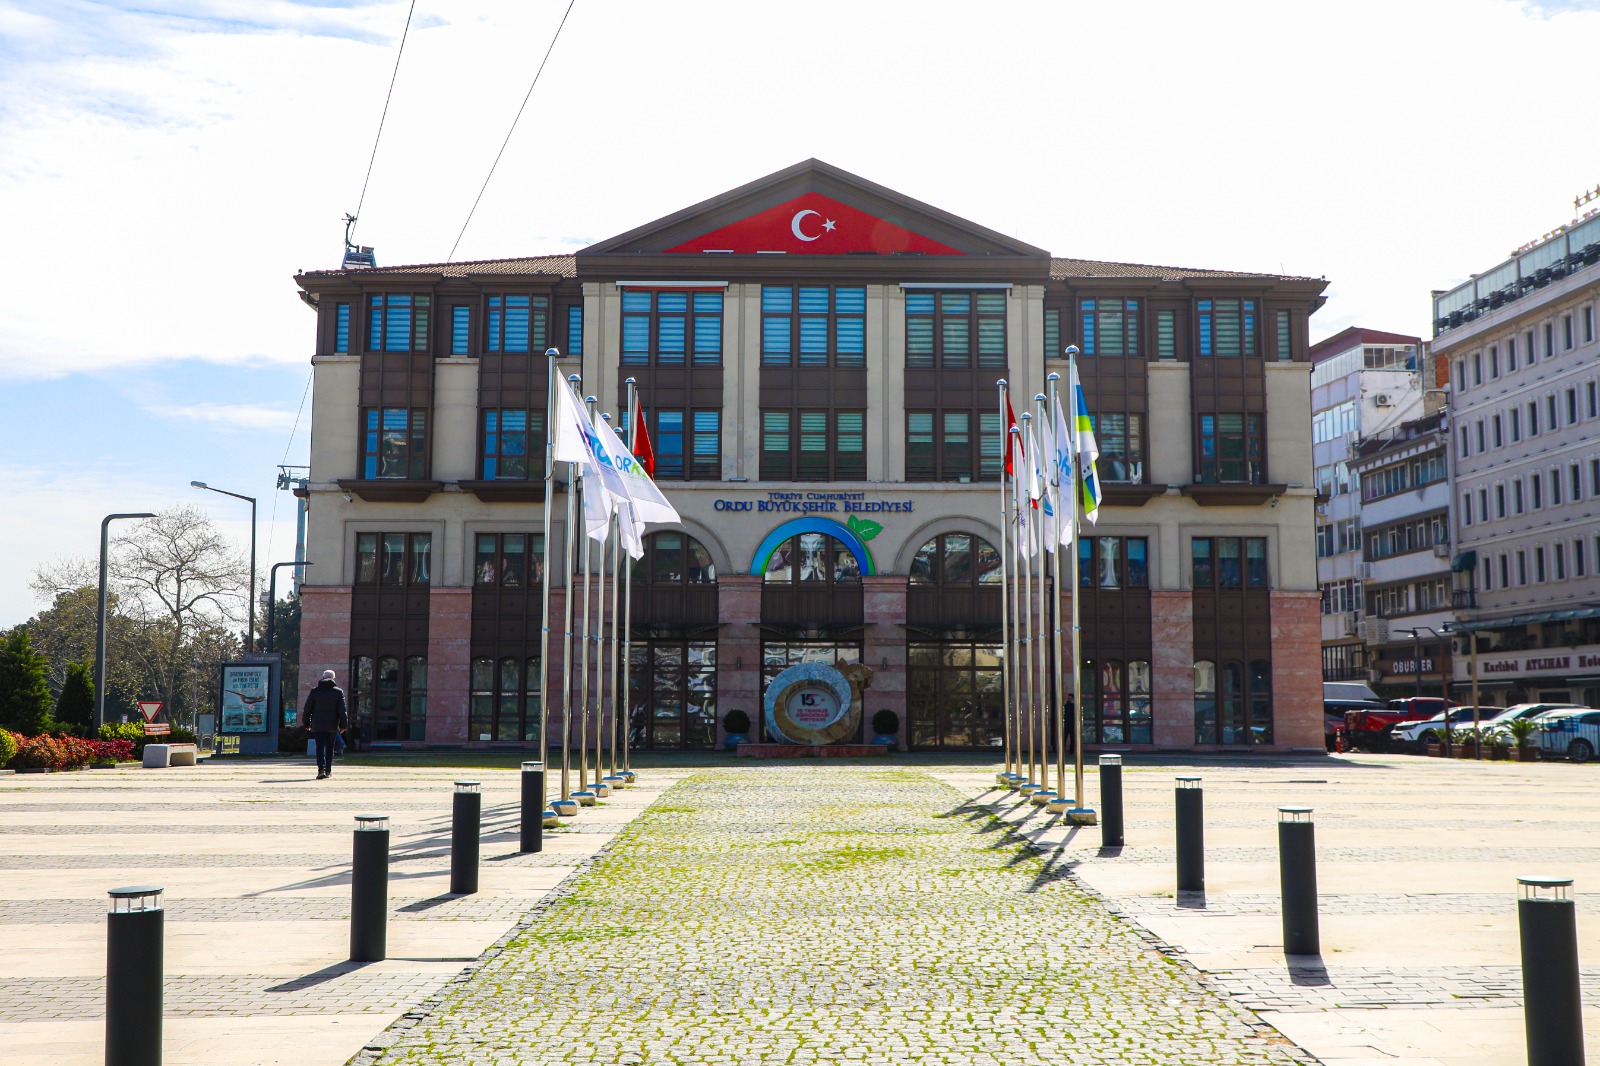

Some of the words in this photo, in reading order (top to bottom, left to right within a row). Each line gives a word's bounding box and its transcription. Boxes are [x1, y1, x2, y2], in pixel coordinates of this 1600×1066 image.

[768, 492, 803, 500] TÜRKİYE
[807, 492, 865, 501] CUMHURİYETİ
[714, 499, 753, 512] ORDU
[757, 499, 839, 515] BÜYÜKŞEHİR
[844, 499, 914, 513] BELEDİYESİ
